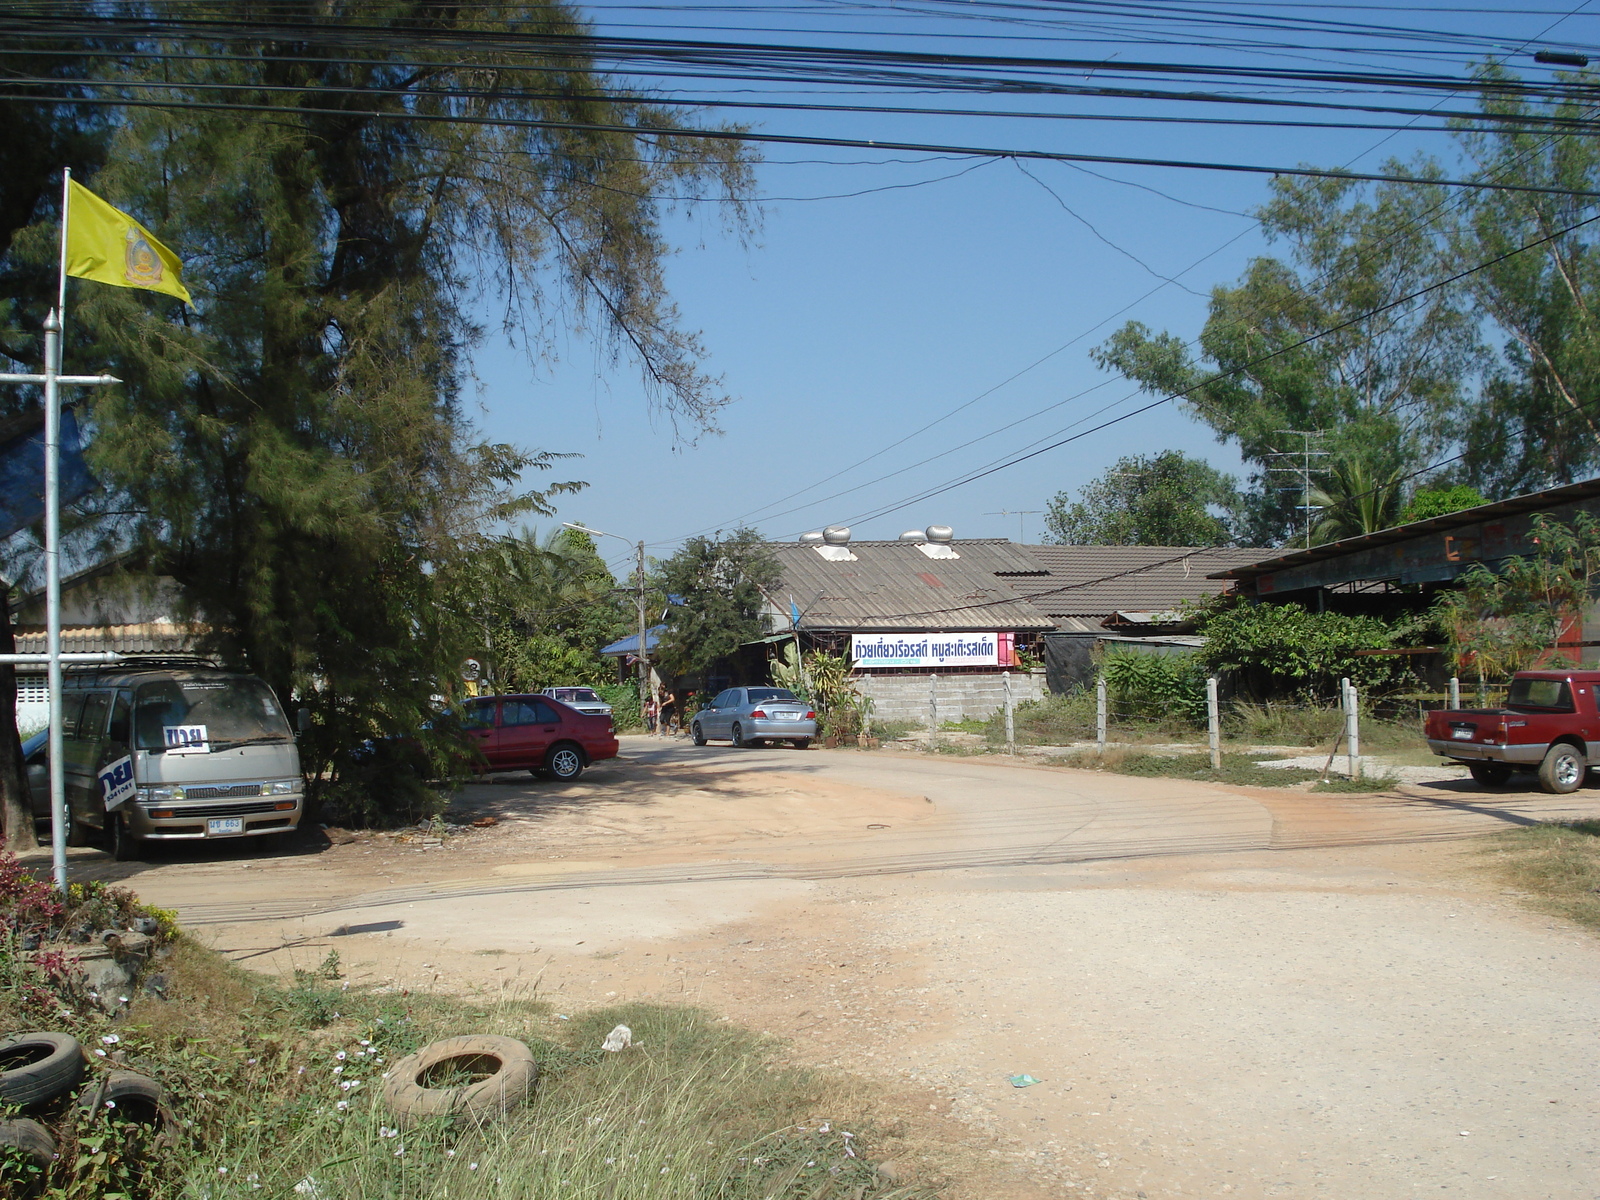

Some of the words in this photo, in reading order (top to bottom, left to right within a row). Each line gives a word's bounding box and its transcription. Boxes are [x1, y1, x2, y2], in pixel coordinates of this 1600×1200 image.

[931, 636, 993, 662] หมูสะเต๊ะรสเด็ด
[166, 728, 203, 747] ขาย
[98, 760, 133, 797] าย
